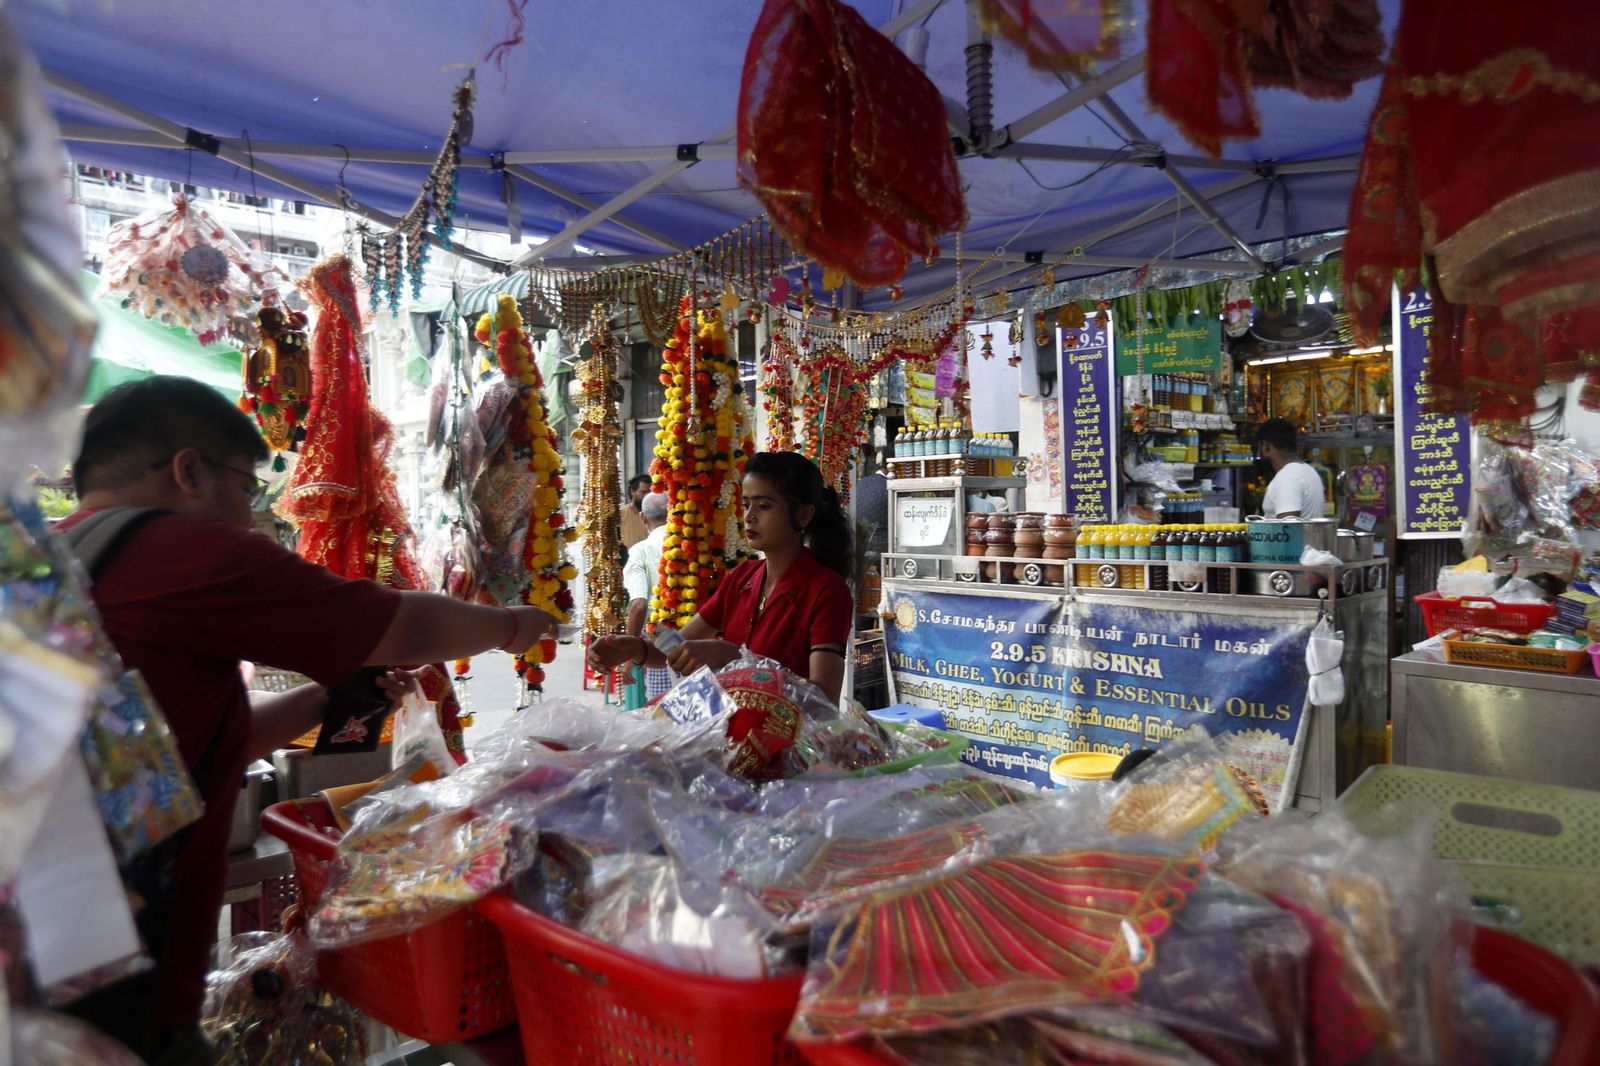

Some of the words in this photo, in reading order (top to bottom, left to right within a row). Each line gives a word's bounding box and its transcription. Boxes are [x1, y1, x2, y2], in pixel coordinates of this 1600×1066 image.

[990, 640, 1047, 664] 2.9.5
[1051, 645, 1164, 680] KRISHNA
[1069, 675, 1086, 697] &
